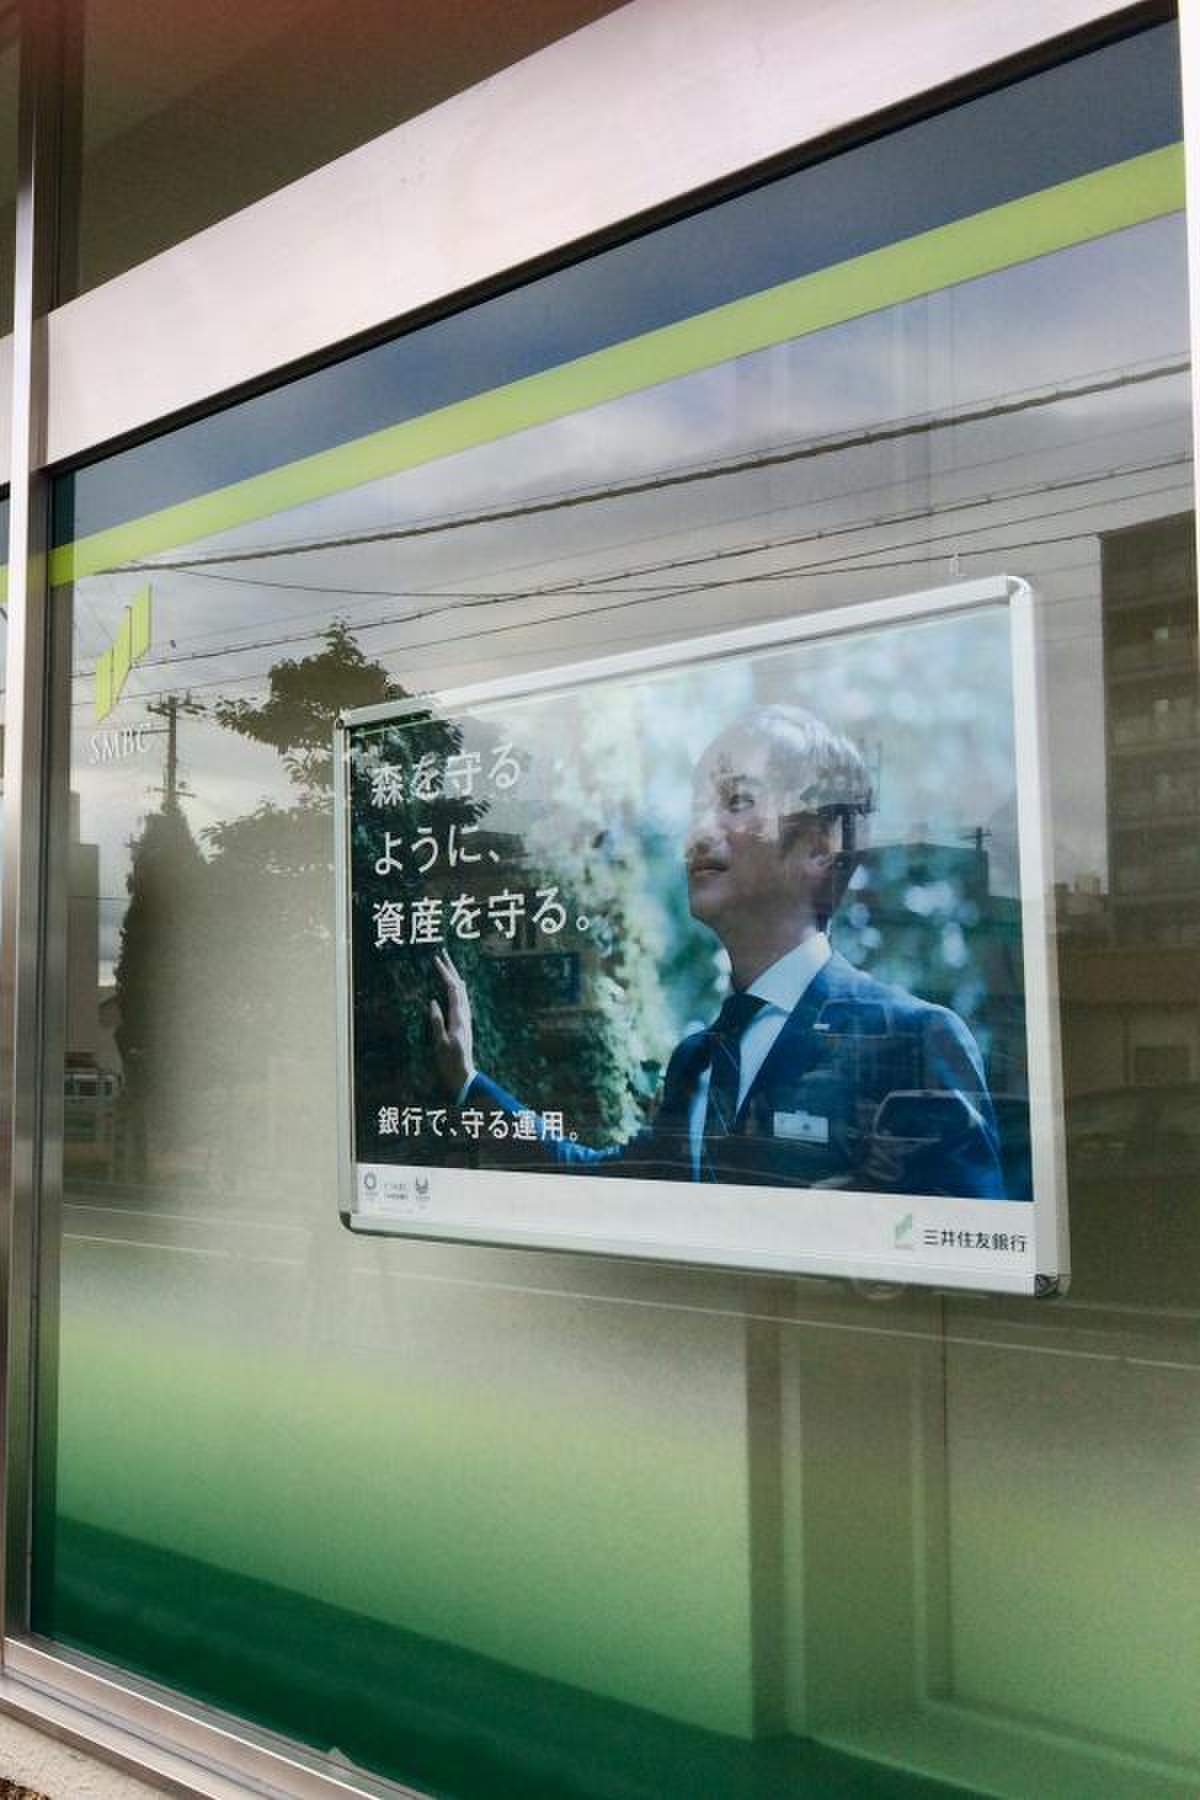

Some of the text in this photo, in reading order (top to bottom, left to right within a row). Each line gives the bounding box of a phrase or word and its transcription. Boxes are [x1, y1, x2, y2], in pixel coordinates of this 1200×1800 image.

[370, 742, 521, 808] 森を守る
[374, 824, 500, 876] ように、
[371, 887, 590, 948] 資産を守る。
[377, 1105, 578, 1142] 銀行で、守る運用。
[923, 1229, 1028, 1252] 三井住友銀行
